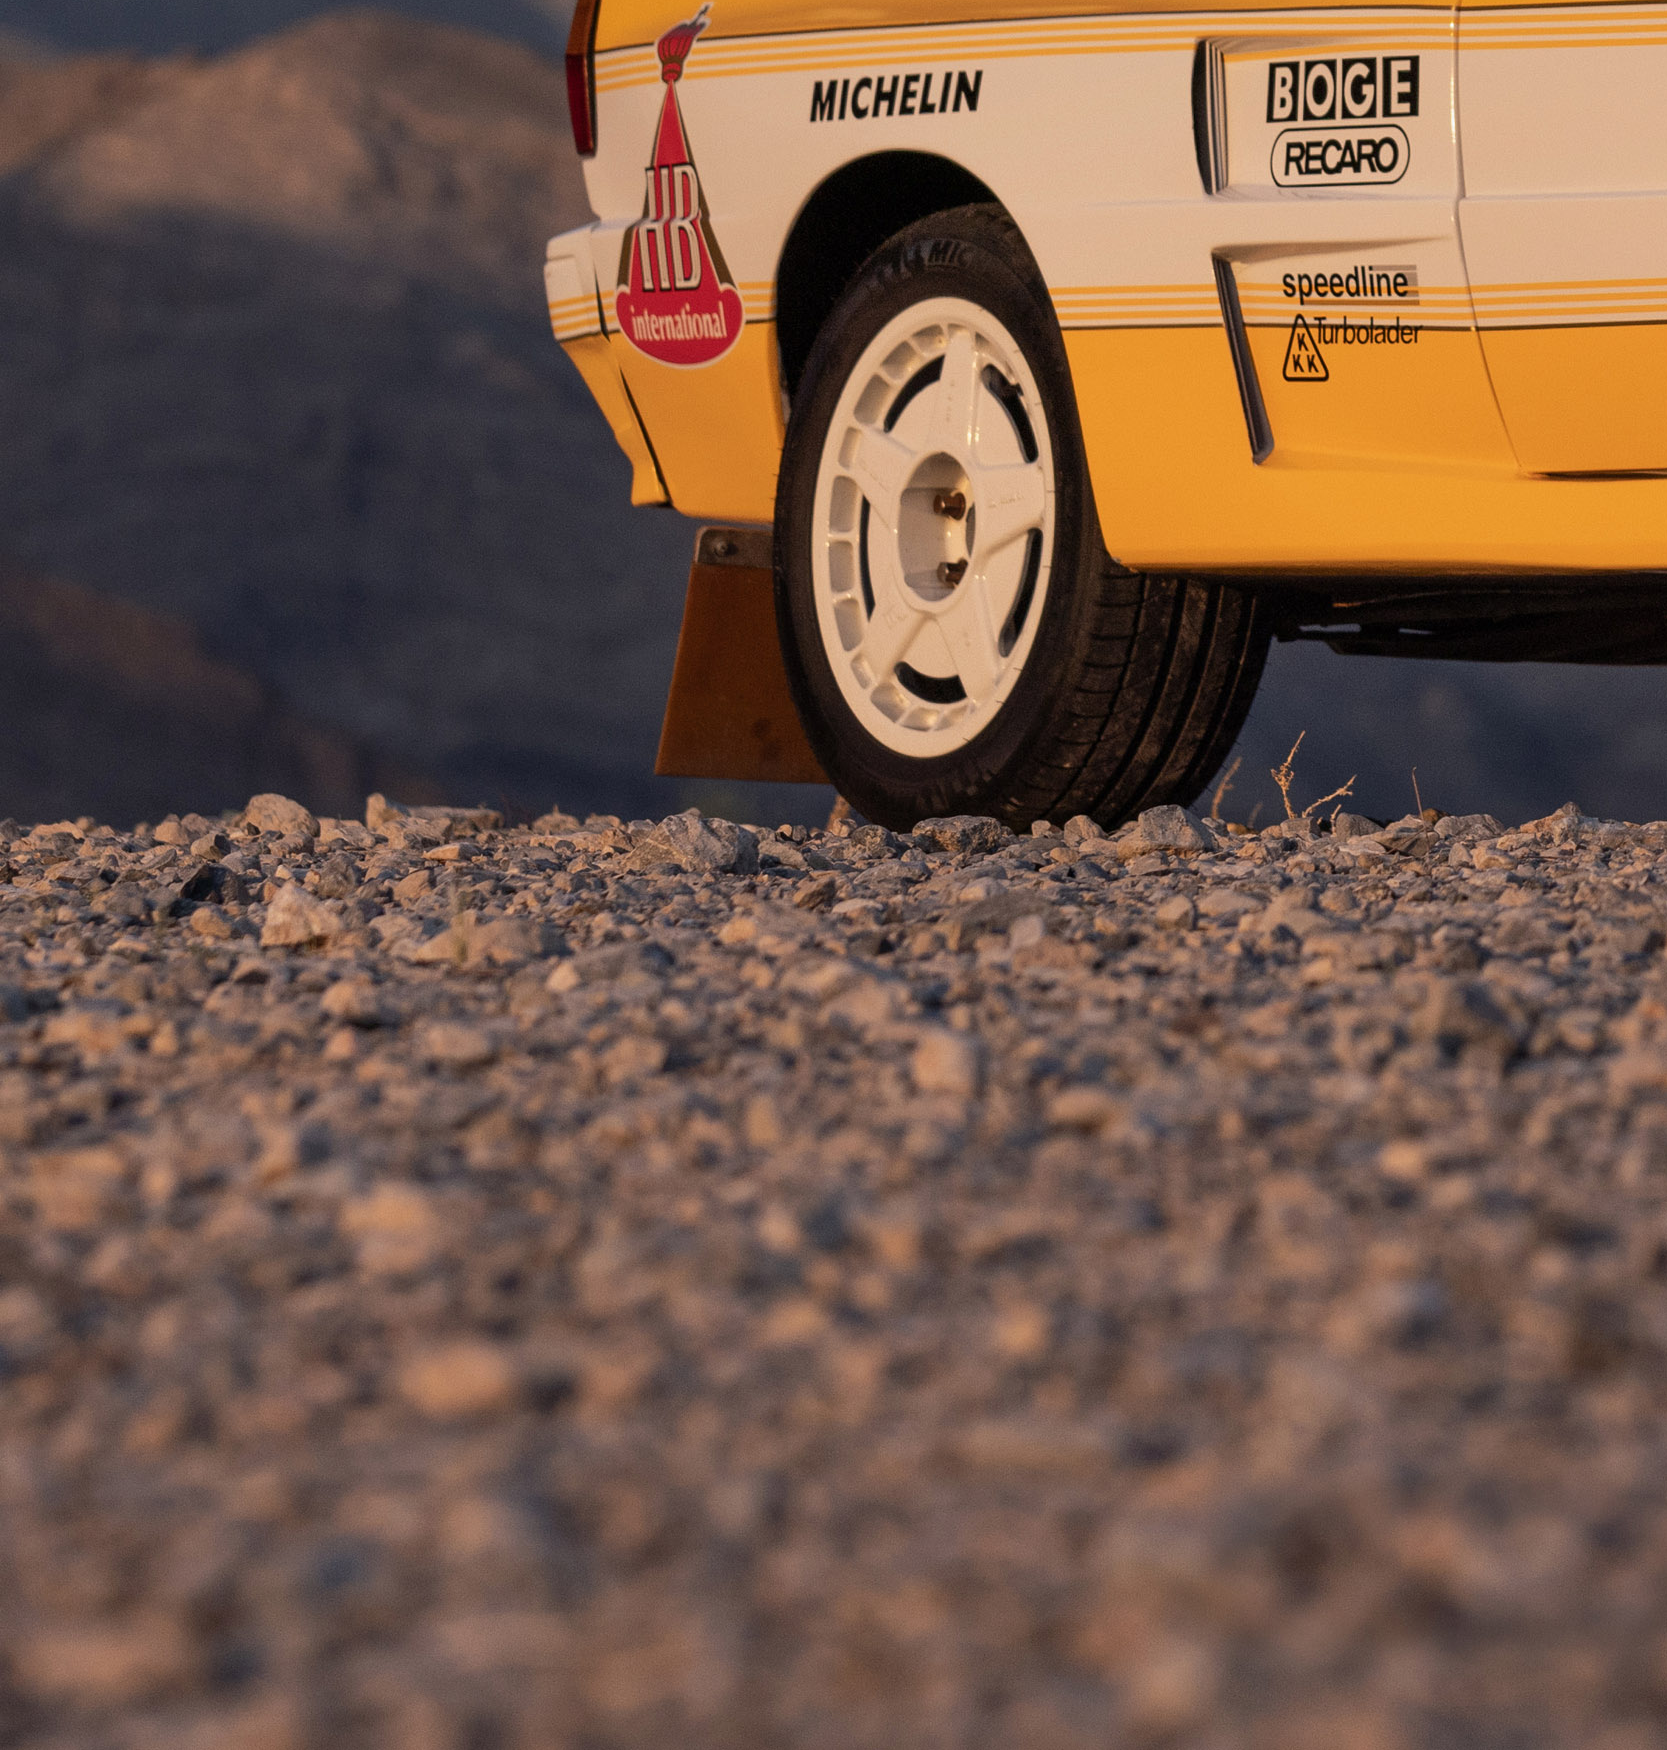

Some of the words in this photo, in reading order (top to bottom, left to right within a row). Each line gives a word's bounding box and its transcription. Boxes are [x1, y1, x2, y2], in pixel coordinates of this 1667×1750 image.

[809, 70, 984, 122] MICHELIN
[1269, 58, 1415, 121] BOGE
[1284, 137, 1399, 176] RECARO
[638, 164, 702, 292] HB
[1283, 266, 1409, 305] speedline
[630, 300, 727, 344] international
[1314, 315, 1424, 344] Turbolader
